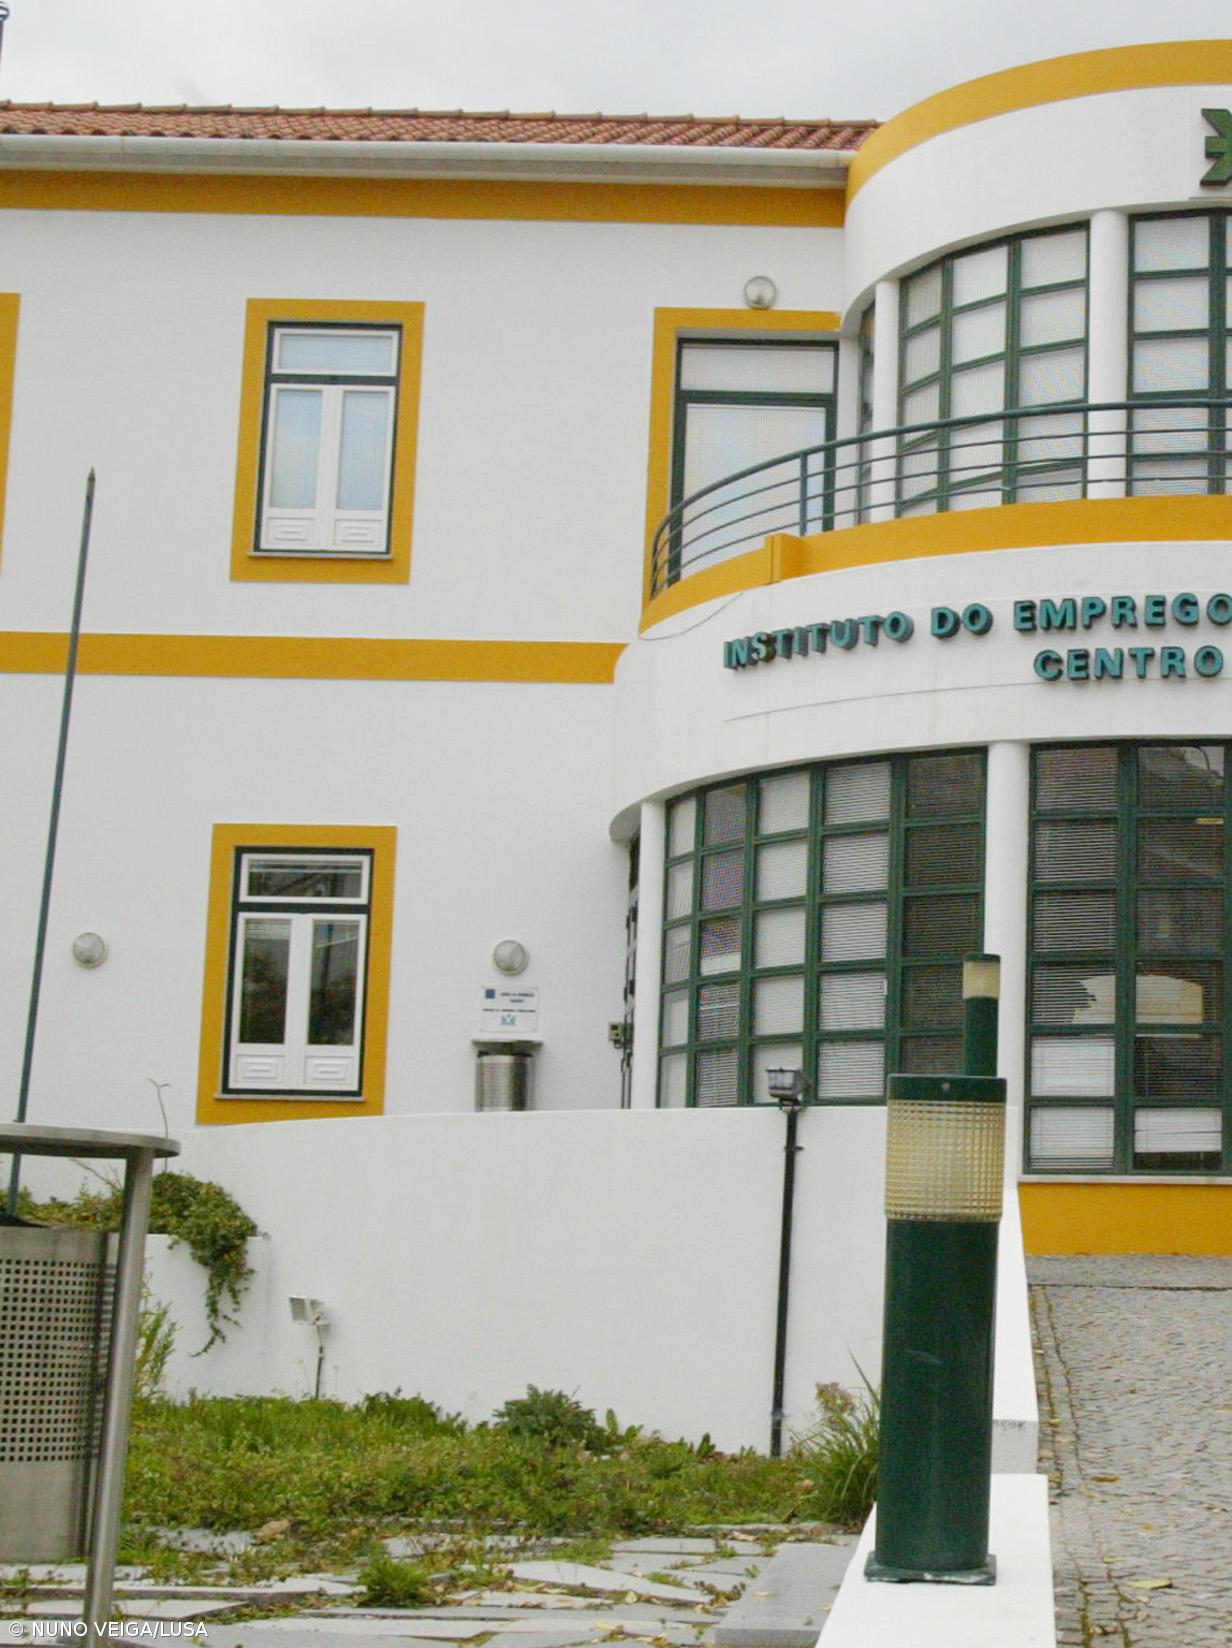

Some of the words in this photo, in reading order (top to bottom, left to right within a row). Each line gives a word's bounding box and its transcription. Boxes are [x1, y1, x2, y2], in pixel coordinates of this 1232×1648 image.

[723, 610, 915, 670] INSTITUTO
[930, 603, 994, 639] DO
[1033, 645, 1224, 682] CENTRO
